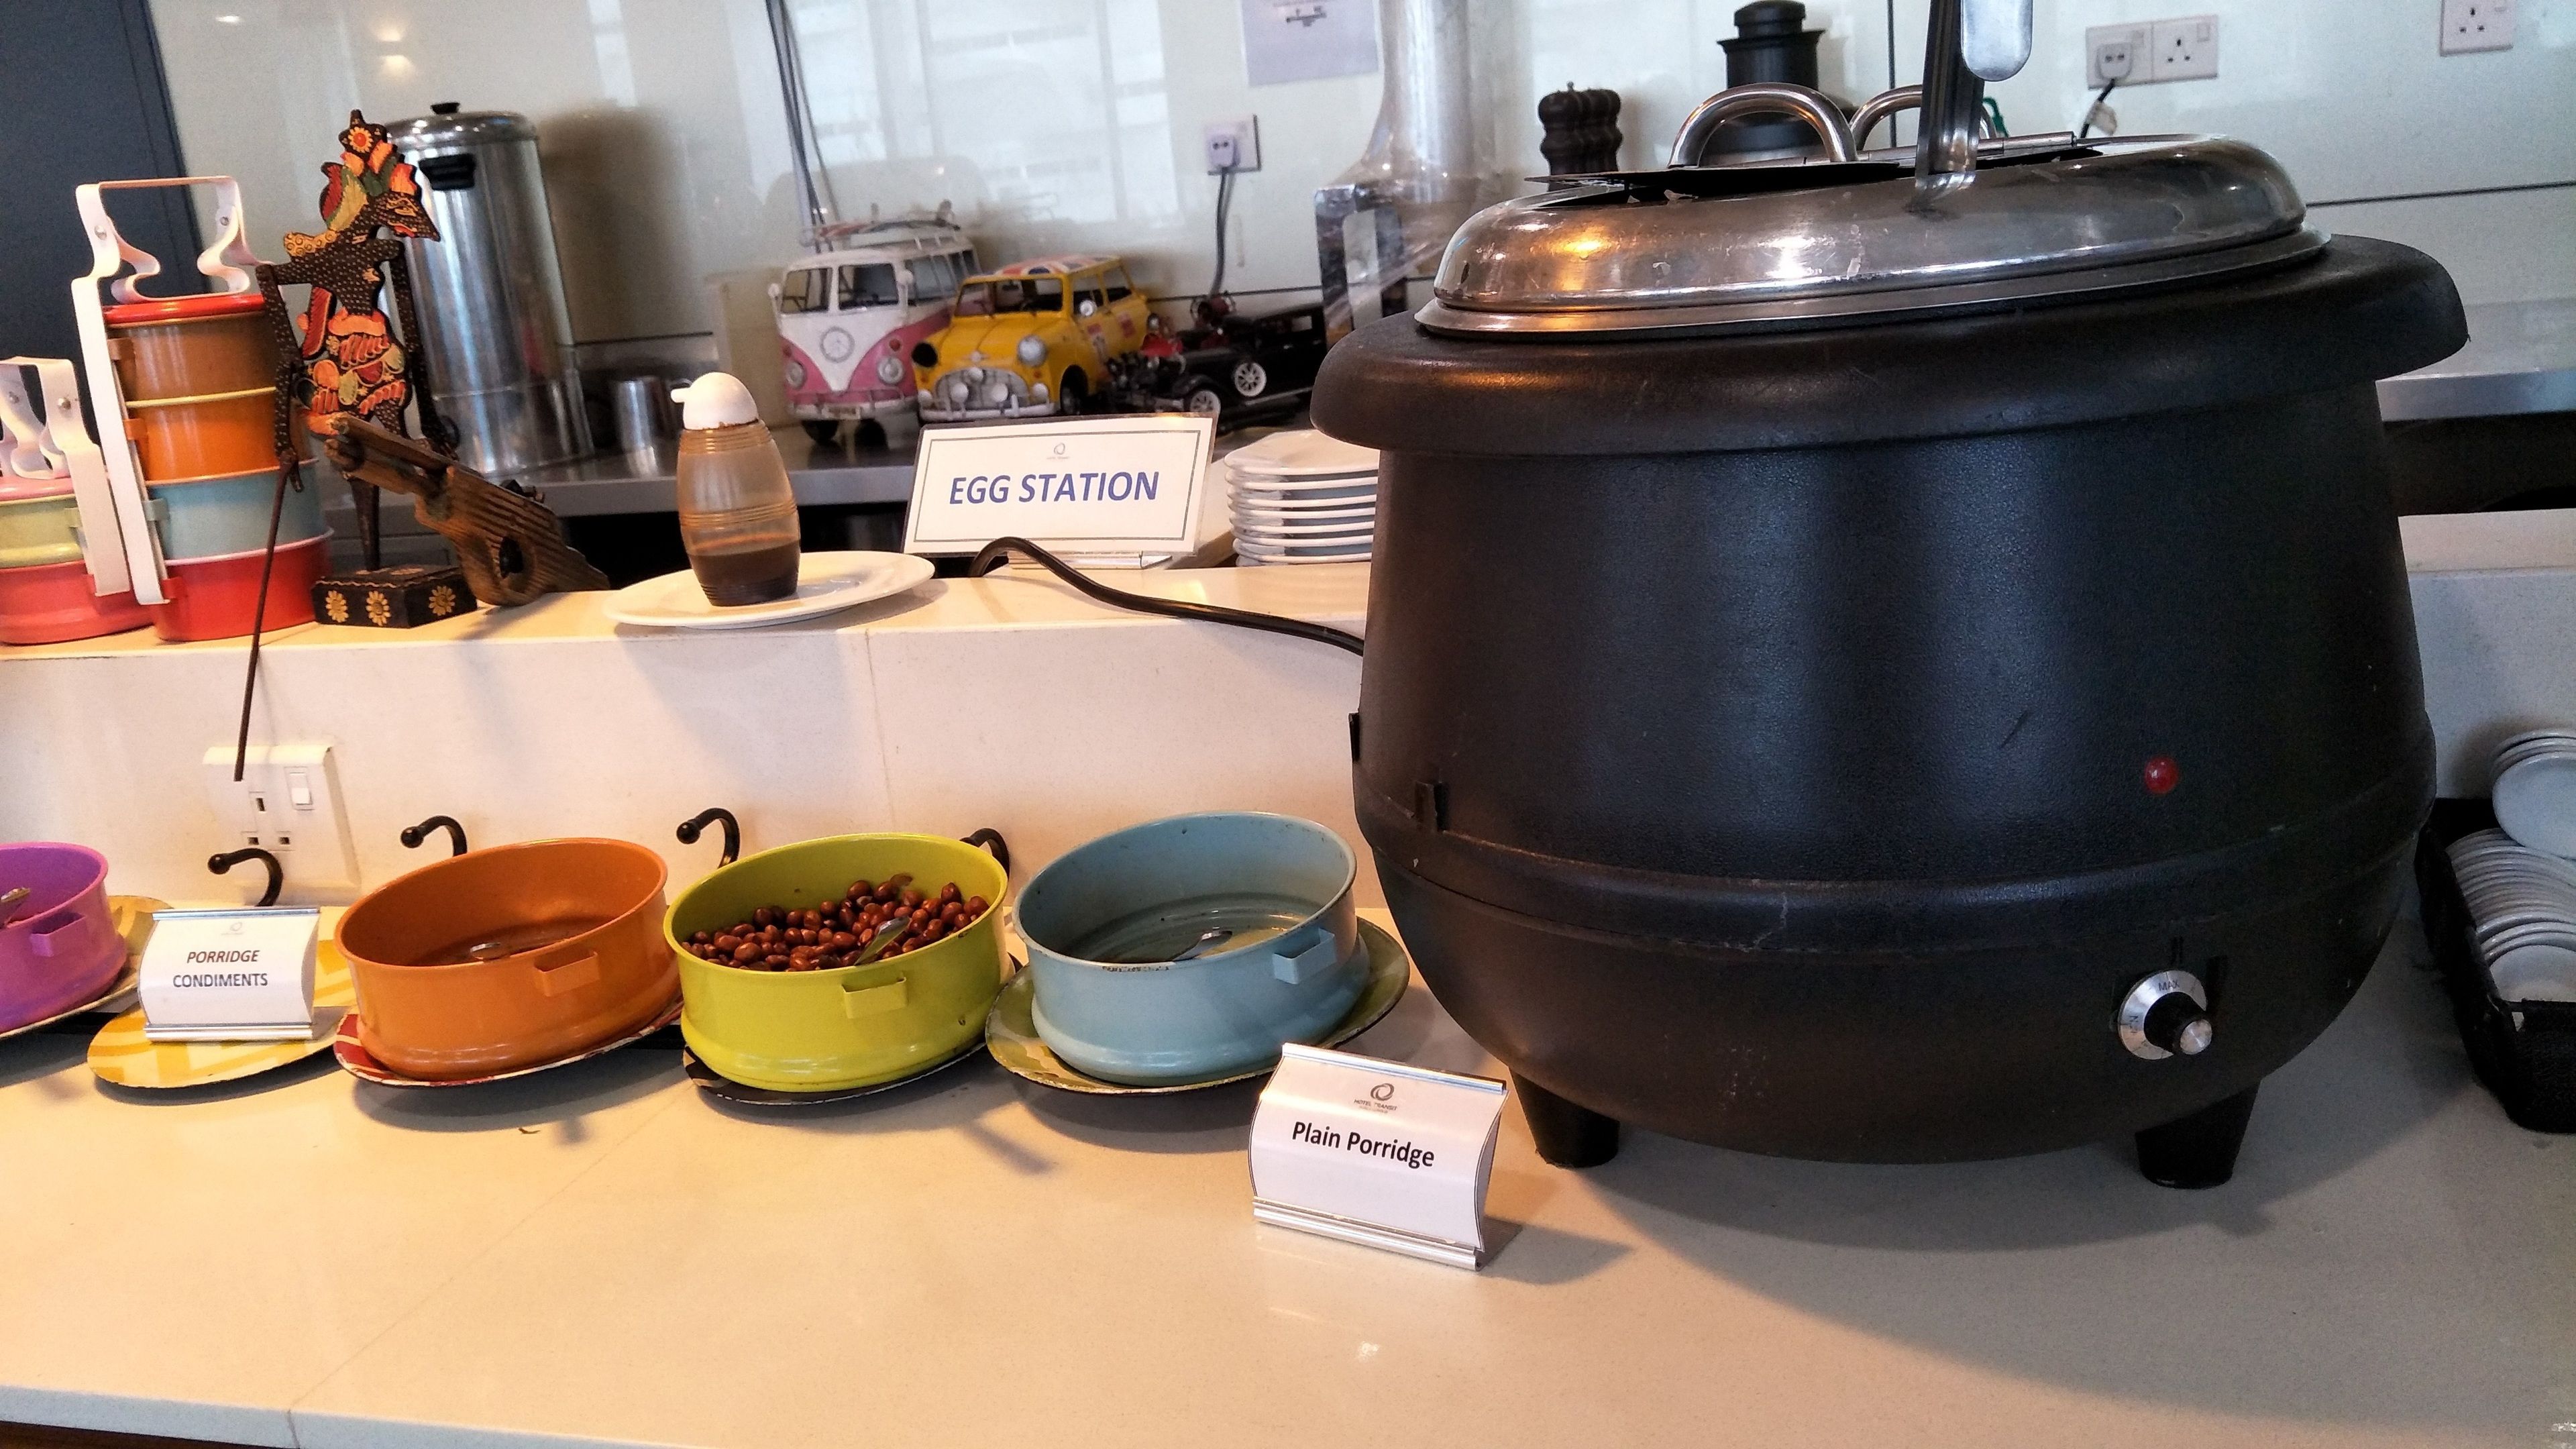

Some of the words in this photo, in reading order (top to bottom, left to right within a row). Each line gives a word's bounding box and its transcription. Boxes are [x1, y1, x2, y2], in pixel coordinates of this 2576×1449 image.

[949, 475, 1011, 504] EGG
[1018, 471, 1159, 502] STATION
[186, 950, 260, 964] PORRIDGE
[172, 973, 268, 988] CONDIMENTS
[2158, 979, 2180, 991] MAX
[1354, 1098, 1371, 1106] HOTEL
[1292, 1121, 1340, 1148] Plain
[1346, 1132, 1434, 1169] Porridge
